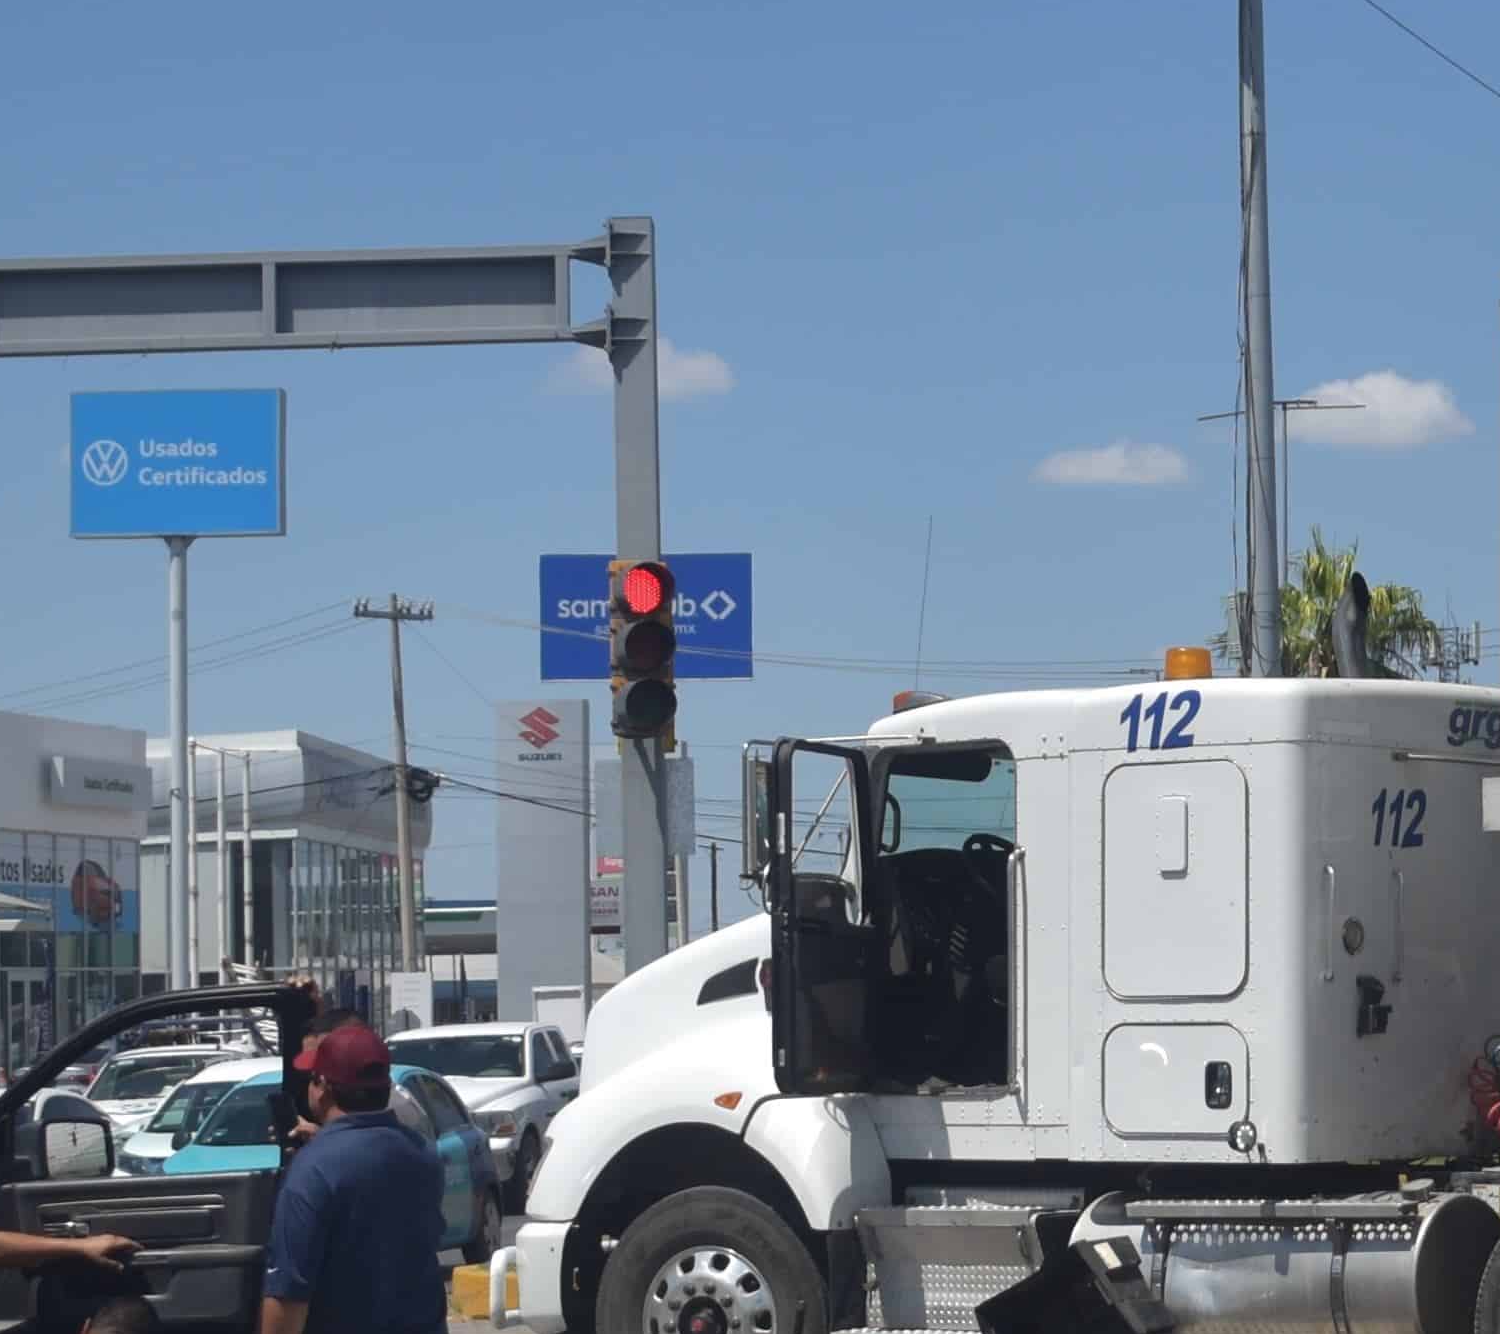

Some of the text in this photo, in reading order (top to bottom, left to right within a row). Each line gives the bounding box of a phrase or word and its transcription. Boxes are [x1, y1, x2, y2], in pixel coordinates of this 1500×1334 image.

[139, 438, 218, 458] Usados
[138, 466, 268, 486] Certificados
[558, 598, 611, 619] sam
[1119, 690, 1202, 753] 112
[1372, 788, 1428, 849] 112
